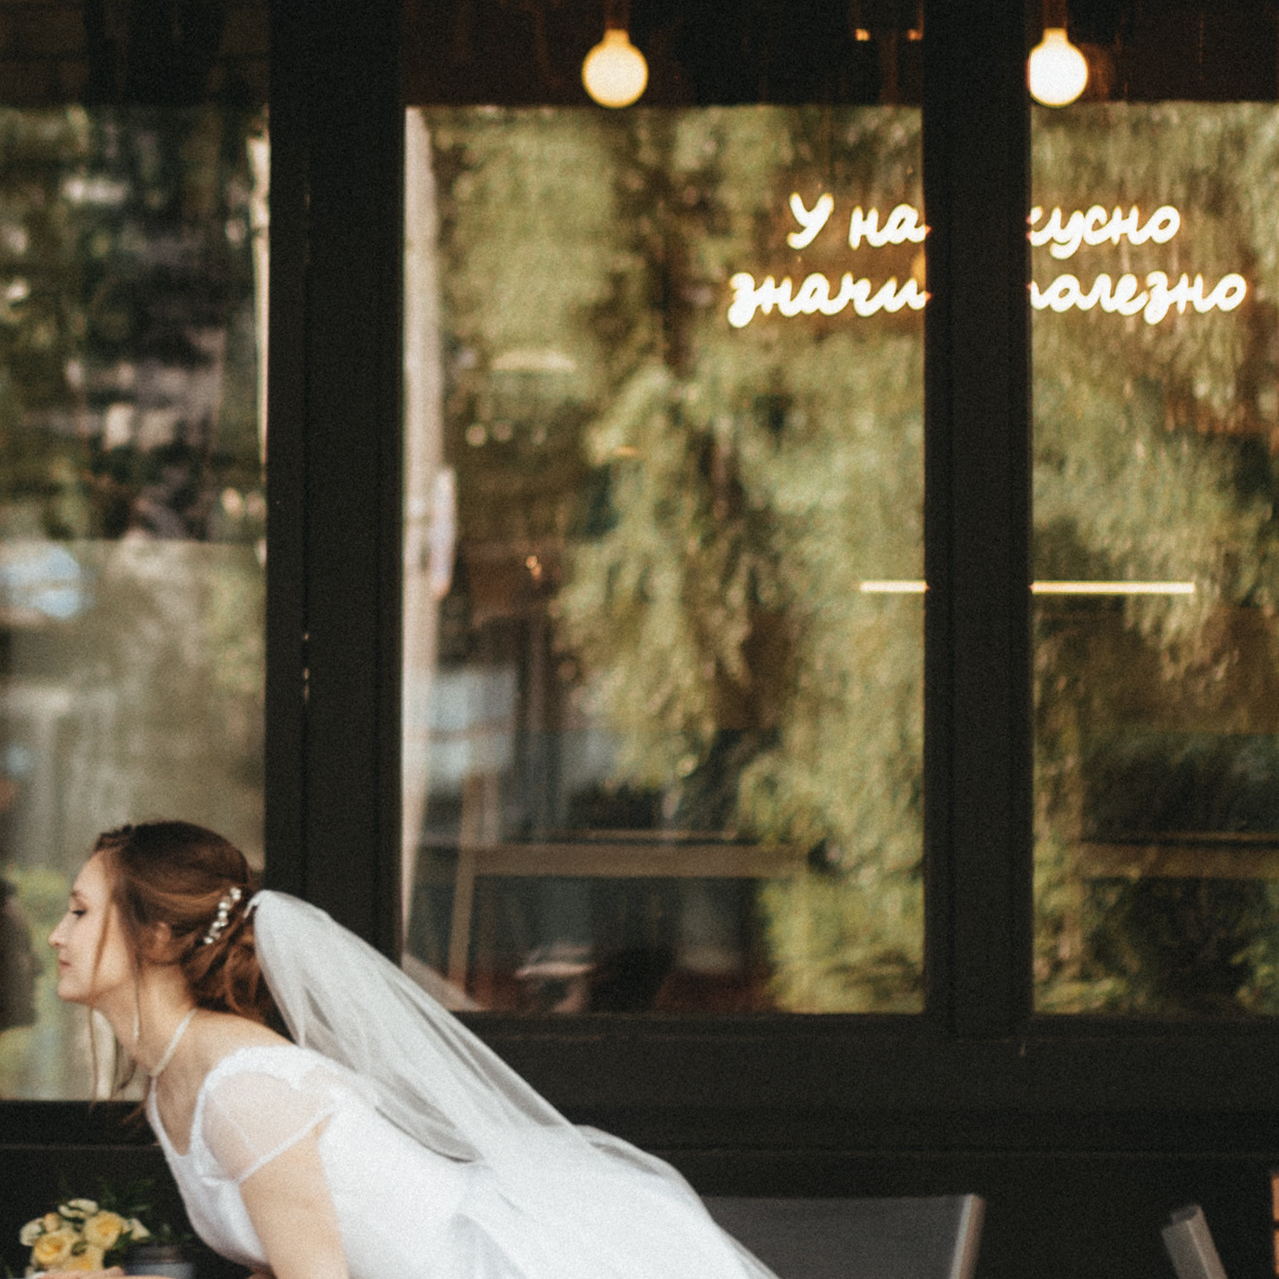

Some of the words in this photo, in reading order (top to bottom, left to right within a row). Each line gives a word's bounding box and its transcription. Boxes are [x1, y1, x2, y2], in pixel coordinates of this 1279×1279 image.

[787, 192, 835, 250] У
[848, 203, 929, 250] на
[727, 271, 929, 328] значи
